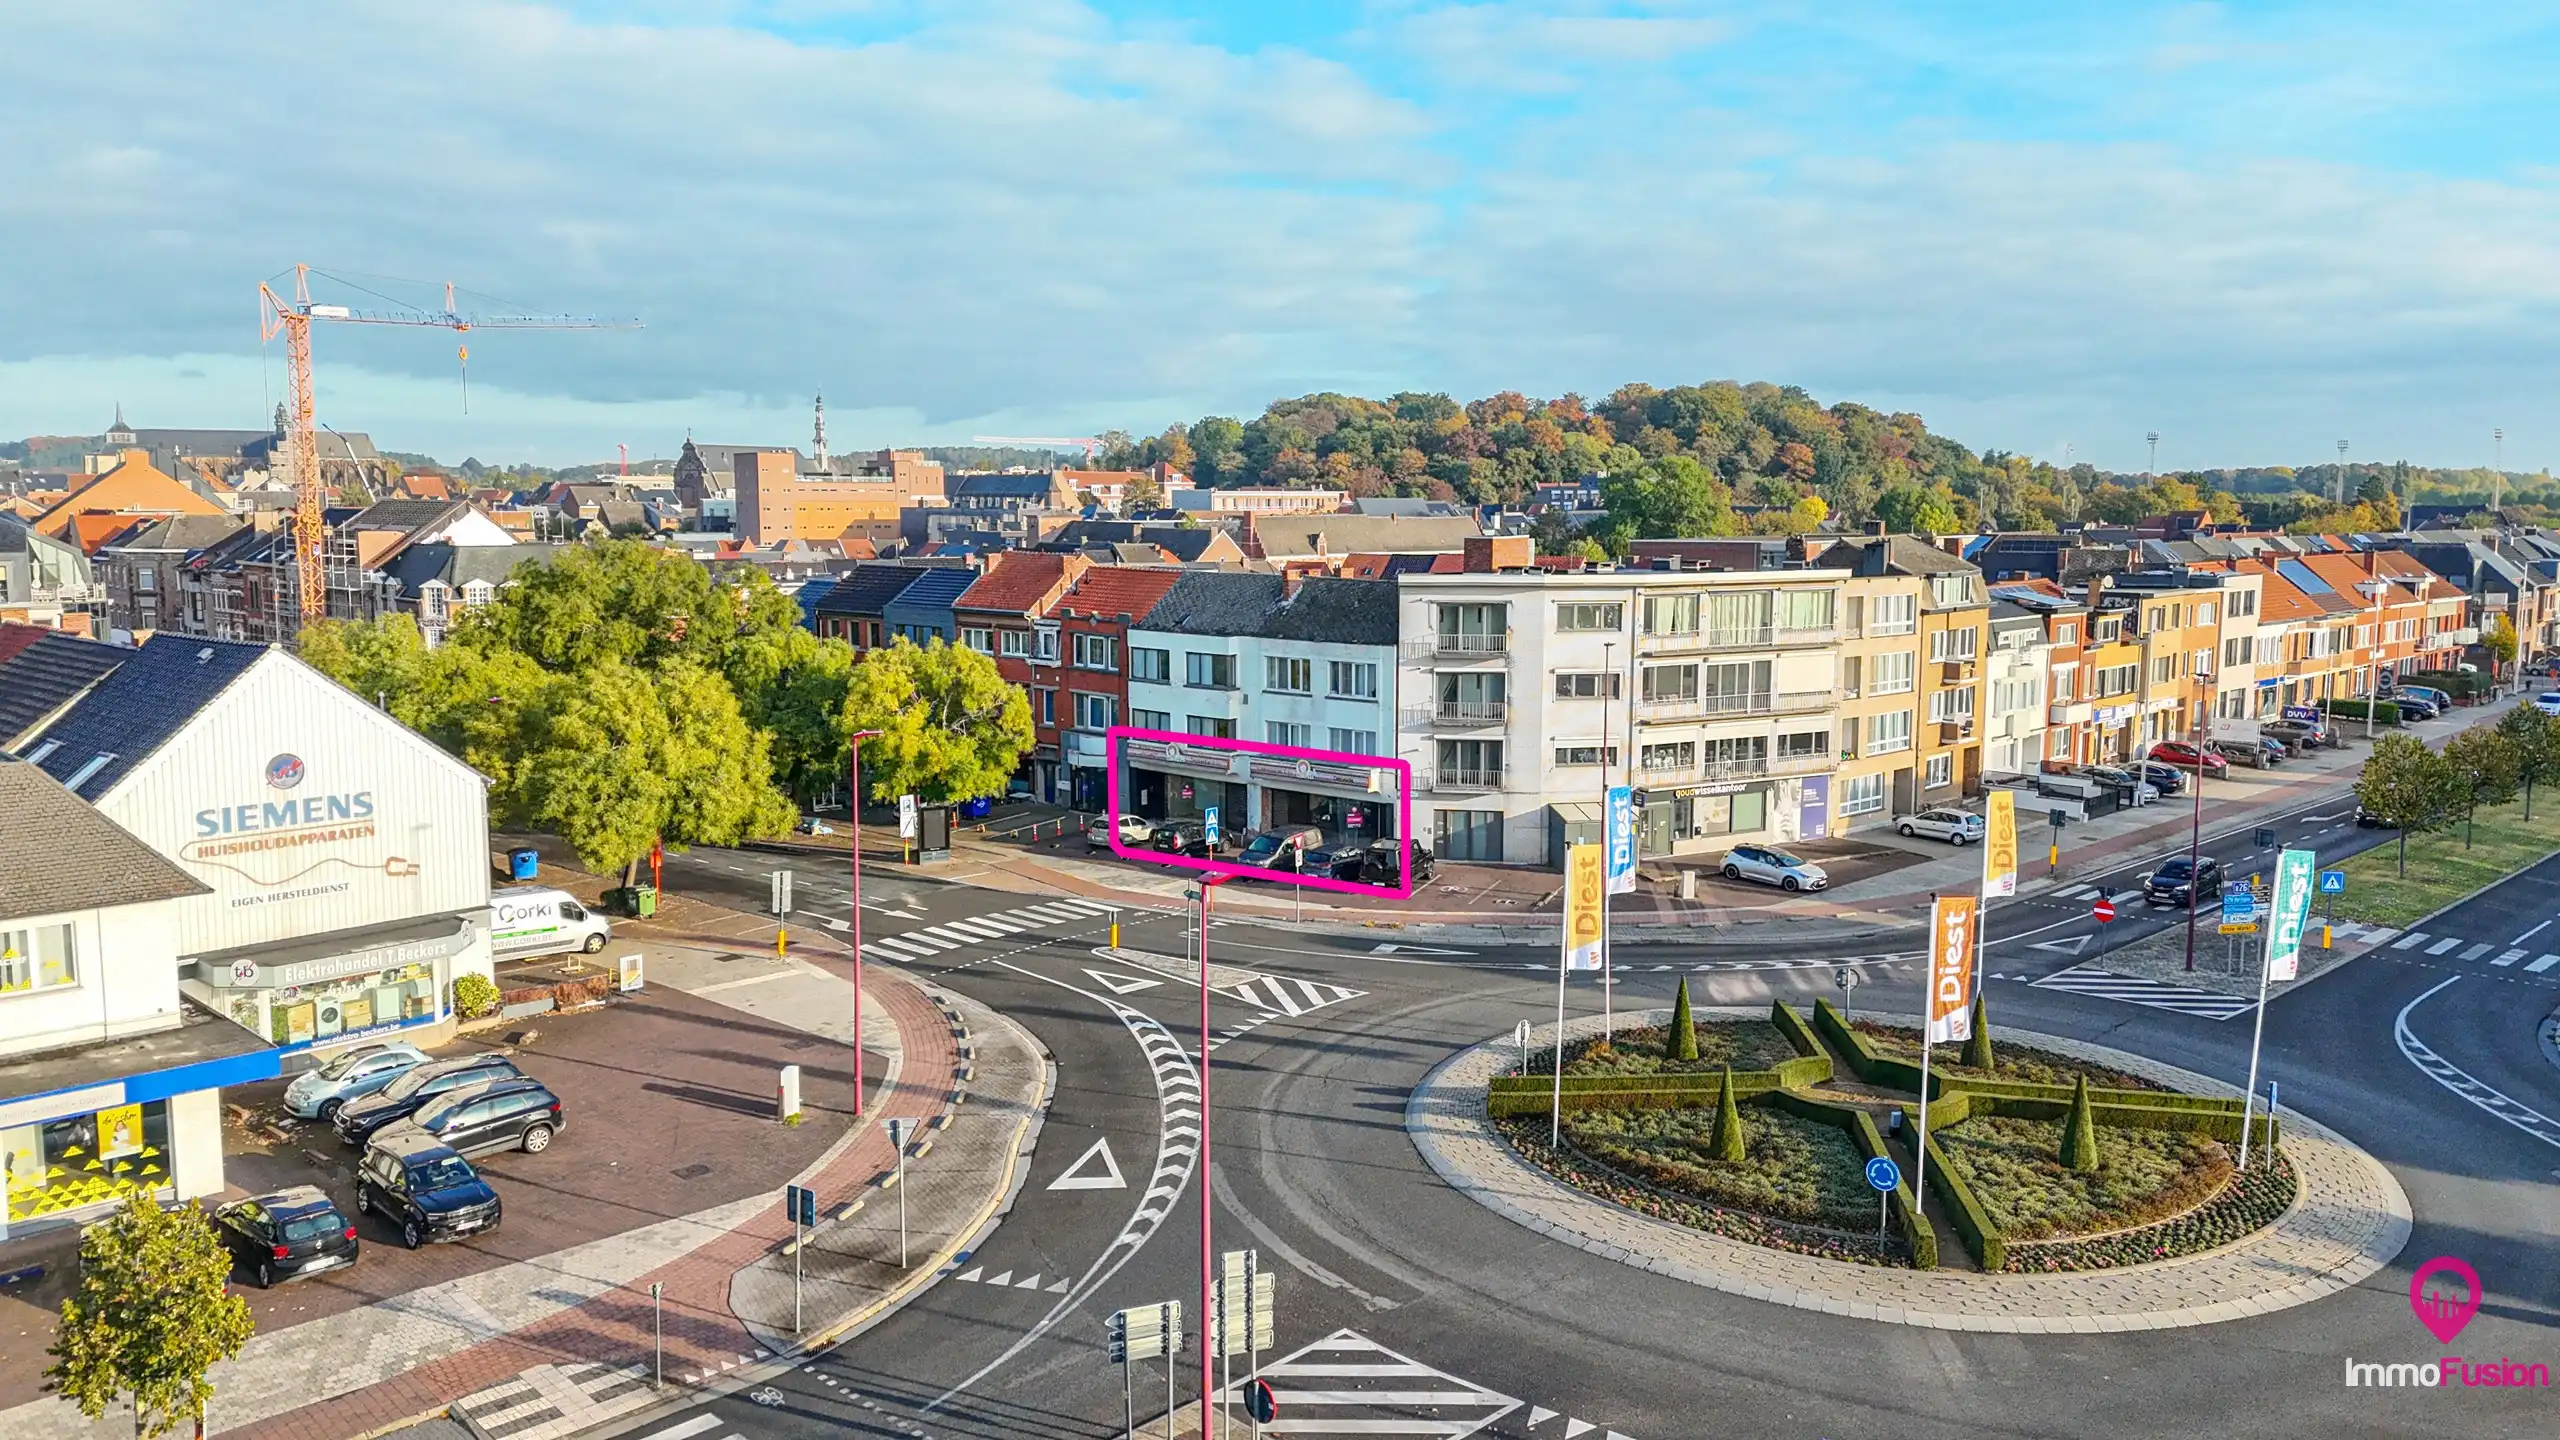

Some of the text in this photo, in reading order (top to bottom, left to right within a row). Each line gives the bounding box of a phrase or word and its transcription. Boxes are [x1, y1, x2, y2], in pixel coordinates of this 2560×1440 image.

[2287, 710, 2307, 719] DVV
[1675, 784, 1747, 799] goudwisselkantoor
[196, 791, 374, 837] SIEMENS
[1612, 792, 1629, 865] Diest
[197, 825, 375, 859] HUISHOUDAPPARATEN
[1993, 801, 2013, 868] Diest
[231, 882, 350, 908] EIGEN HERSTELDIENST
[499, 903, 551, 924] Corki
[1574, 856, 1598, 936] Diest
[2279, 863, 2308, 945] Diest
[284, 951, 382, 983] Elektrohandel
[1938, 911, 1967, 1003] Diest
